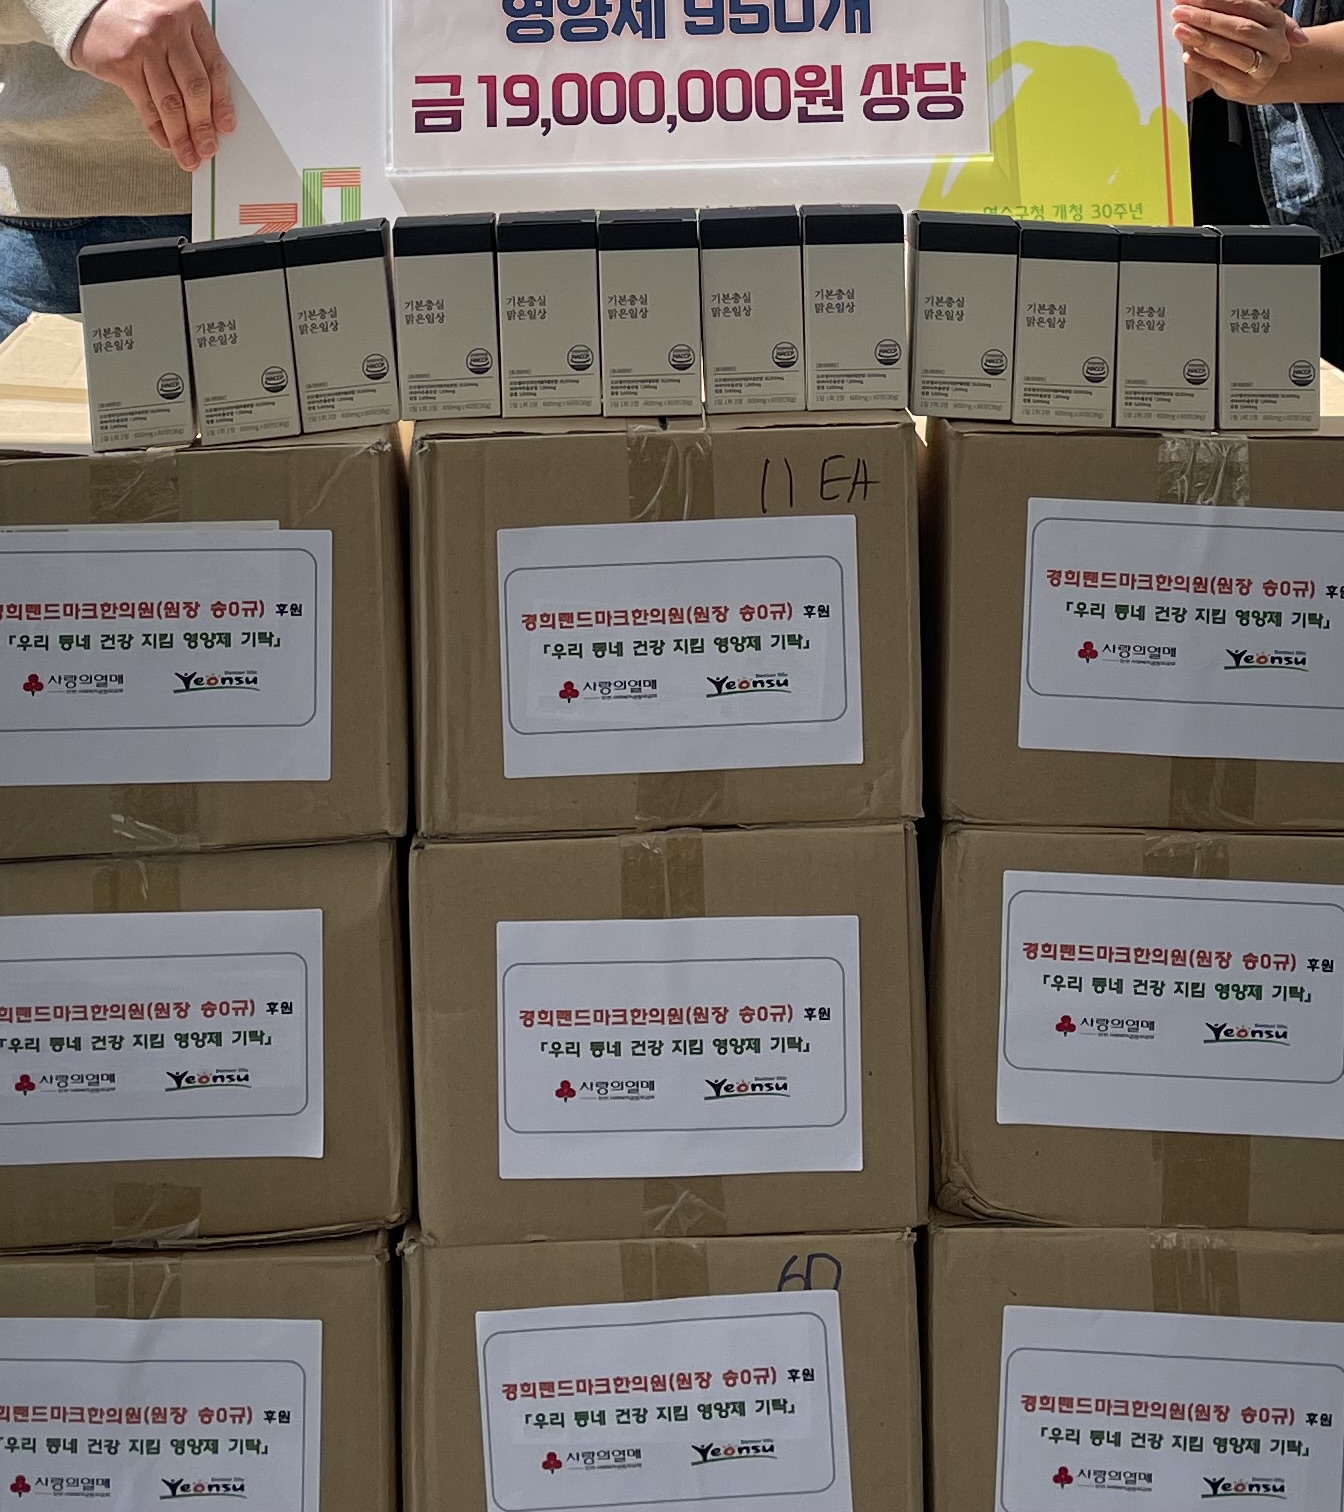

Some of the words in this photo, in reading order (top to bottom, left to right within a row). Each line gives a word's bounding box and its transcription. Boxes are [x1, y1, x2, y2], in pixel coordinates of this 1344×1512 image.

[412, 76, 464, 133] 금
[478, 67, 844, 137] 19,000,000원
[860, 63, 966, 121] 상당
[1054, 204, 1083, 221] 개청
[1092, 202, 1143, 220] 30주년
[819, 454, 880, 503] EA
[274, 602, 302, 617] 후원
[802, 604, 830, 619] 후원
[1114, 603, 1146, 621] 동네
[1154, 605, 1188, 623] 건강
[1194, 607, 1226, 625] 지킴
[1235, 609, 1282, 627] 영양제
[58, 634, 91, 651] 동네
[100, 633, 134, 650] 건강
[141, 632, 174, 649] 지킴
[182, 632, 231, 649] 영양제
[591, 641, 624, 659] 동네
[632, 639, 666, 656] 건강
[672, 637, 705, 654] 지킴
[713, 635, 761, 654] 영양제
[1226, 649, 1307, 672] Yeonsu
[174, 671, 259, 690] Yeonsu
[706, 673, 790, 694] Yeonsu
[1306, 958, 1334, 973] 후원
[1091, 976, 1123, 994] 동네
[1132, 978, 1166, 997] 건강
[1173, 980, 1206, 998] 지킴
[1214, 982, 1263, 1001] 영양제
[265, 1001, 293, 1015] 후원
[803, 1006, 831, 1022] 후원
[49, 1036, 82, 1053] 동네
[90, 1034, 125, 1051] 건강
[132, 1033, 165, 1049] 지킴
[173, 1031, 222, 1049] 영양제
[1205, 1022, 1289, 1045] Yeonsu
[589, 1040, 621, 1058] 동네
[630, 1039, 664, 1057] 건강
[671, 1038, 703, 1055] 지킴
[712, 1037, 761, 1056] 영양제
[166, 1069, 251, 1089] Yeonsu
[705, 1077, 789, 1097] Yeonsu
[787, 1367, 815, 1383] 후원
[263, 1409, 290, 1424] 후원
[573, 1409, 606, 1428] 동네
[615, 1407, 648, 1425] 건강
[655, 1404, 688, 1422] 지킴
[696, 1400, 746, 1420] 영양제
[1305, 1412, 1332, 1427] 후원
[45, 1437, 78, 1454] 동네
[87, 1438, 121, 1455] 건강
[128, 1438, 161, 1455] 지킴
[169, 1438, 219, 1456] 영양제
[691, 1439, 776, 1462] Yeonsu
[1089, 1429, 1121, 1447] 동네
[1130, 1431, 1164, 1450] 건강
[1171, 1434, 1204, 1452] 지킴
[1212, 1436, 1261, 1454] 영양제
[161, 1478, 246, 1498] Yeonsu
[1203, 1476, 1285, 1499] Yeonsu
